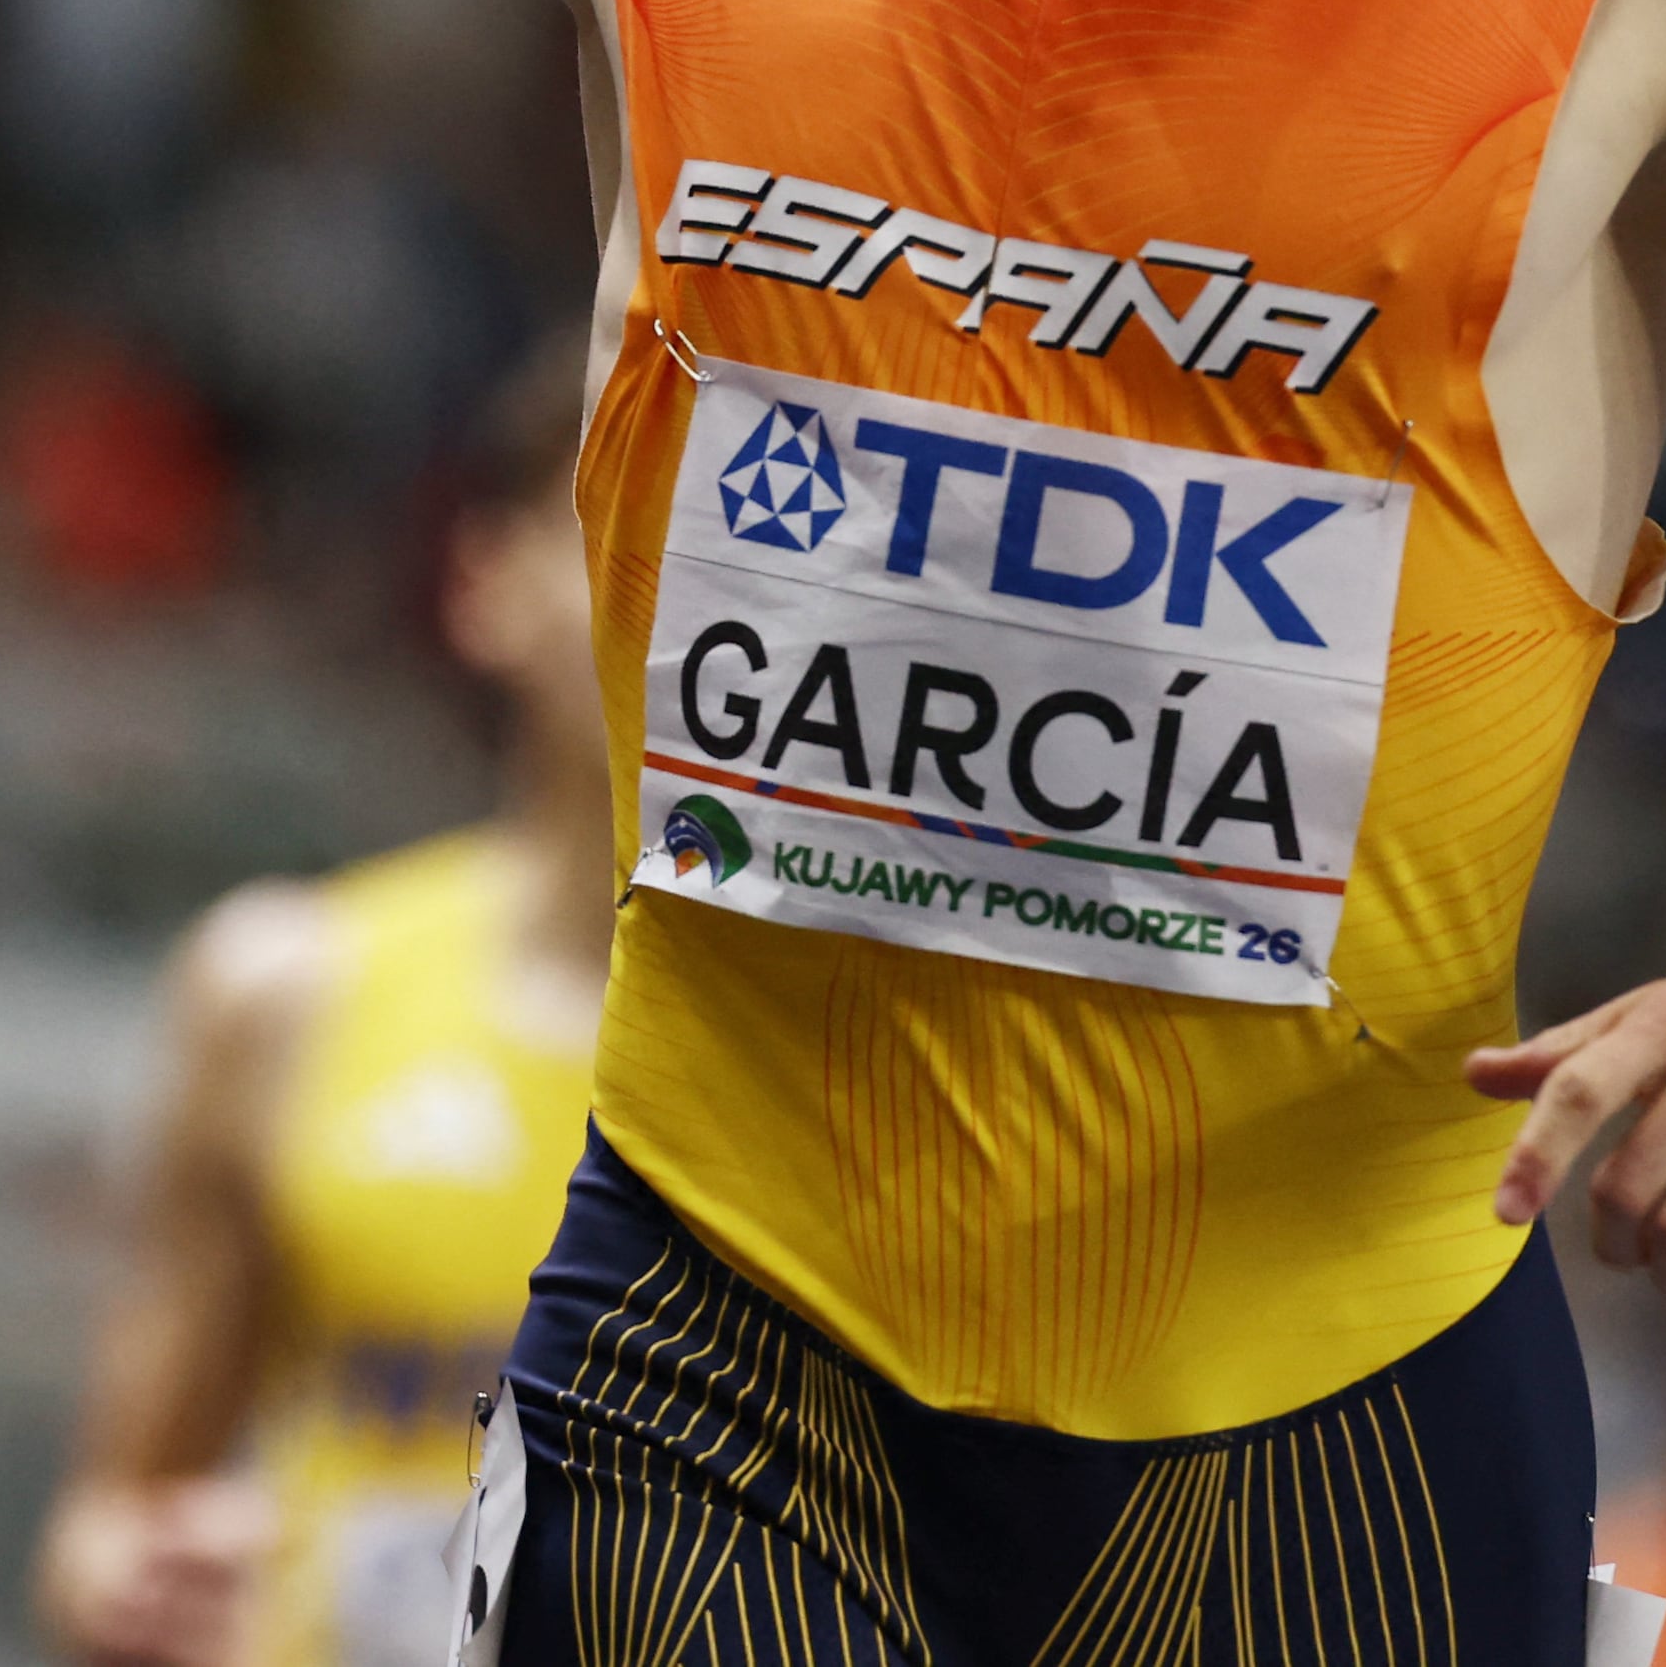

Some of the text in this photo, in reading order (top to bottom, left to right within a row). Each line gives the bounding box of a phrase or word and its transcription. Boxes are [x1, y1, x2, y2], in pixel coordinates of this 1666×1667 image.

[658, 159, 1378, 393] ESPAÑA
[855, 419, 1343, 647] TDK
[681, 621, 1303, 861] GARCÍA
[773, 842, 1301, 965] KUJAWY POMORZE 26
